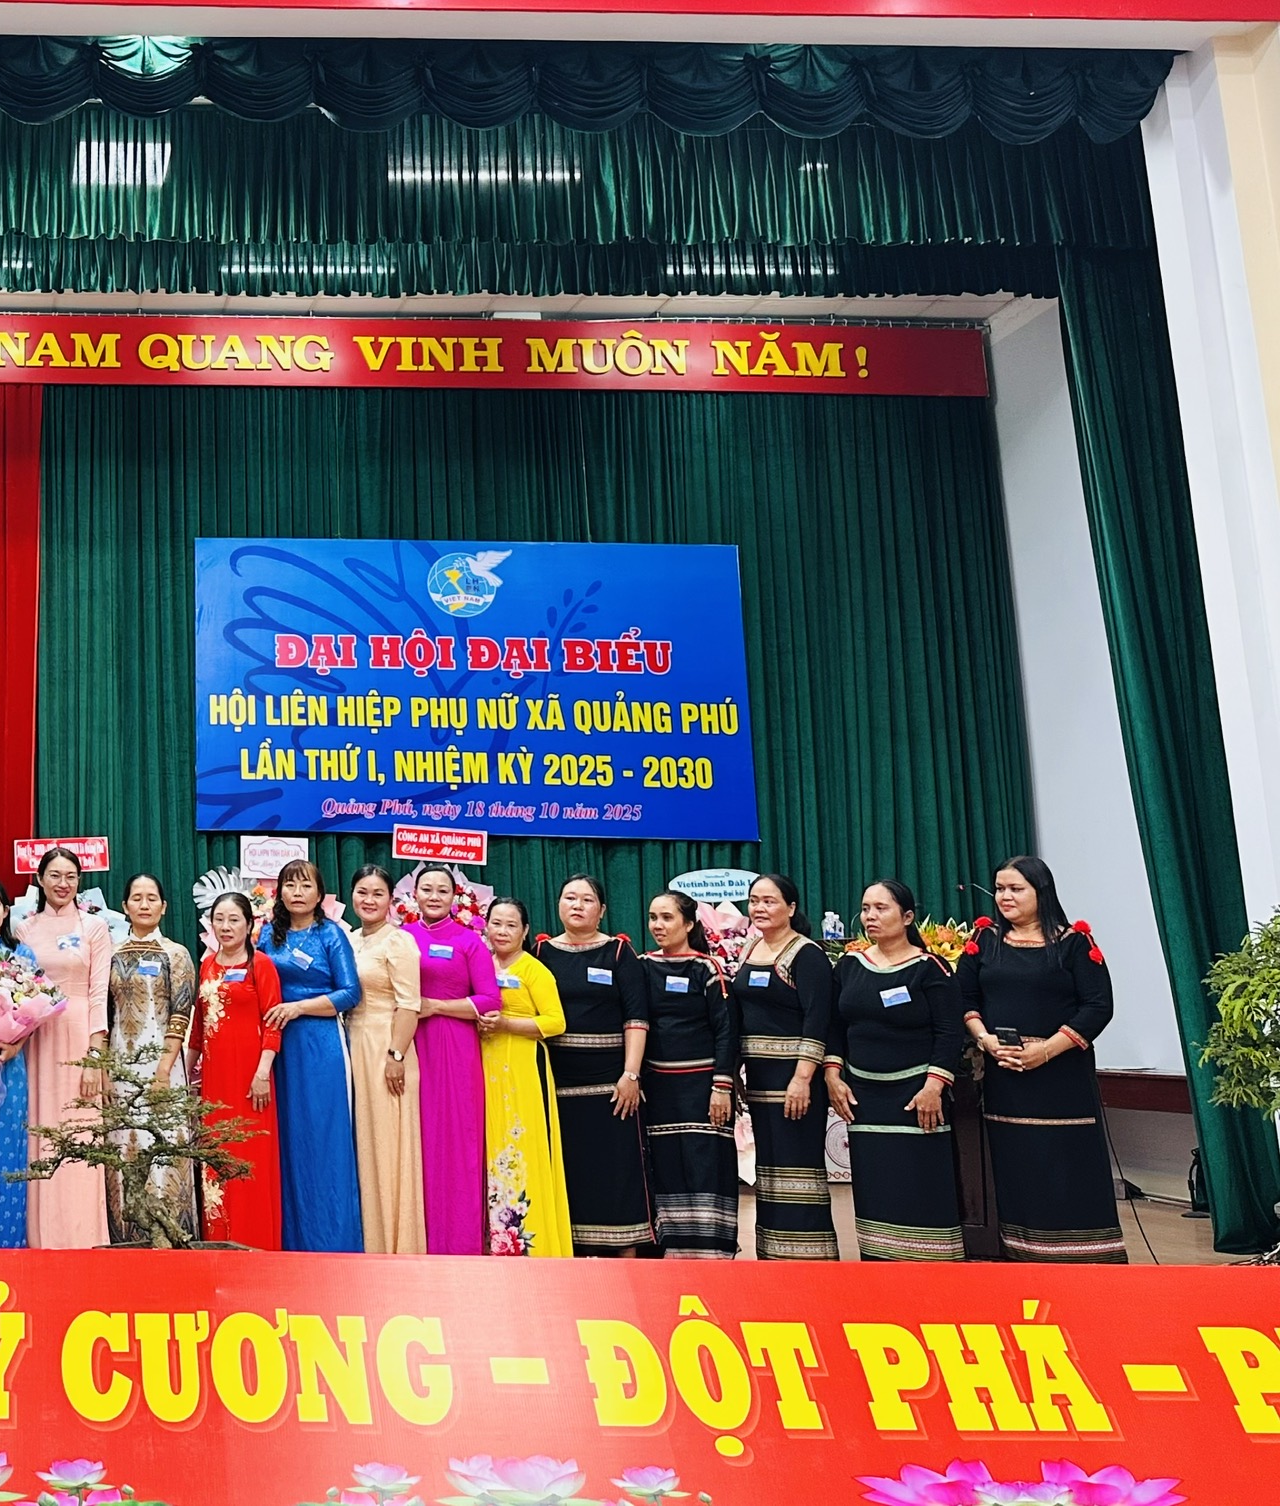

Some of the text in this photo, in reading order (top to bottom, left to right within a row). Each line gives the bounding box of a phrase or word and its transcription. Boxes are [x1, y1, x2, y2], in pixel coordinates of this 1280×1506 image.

[138, 333, 333, 373] QUANG
[353, 335, 504, 373] VINH
[526, 329, 689, 375] MUÔN
[275, 628, 673, 678] ĐẠI HỘI ĐẠI BIỂU
[209, 688, 739, 736] HỘI LIÊN HIỆP PHỤ NỮ XÃ QUẢNG PHÚ
[240, 737, 714, 791] LẦN THỨ I, NHIỆM KỲ 2025 - 2030
[321, 797, 643, 822] Quảng Phú, ngày 18 tháng 10 năm 2025
[397, 830, 482, 847] CÔNG AN XÃ QUẢNG PHÚ
[401, 843, 476, 860] Chúc Mừng
[677, 880, 726, 888] Vietinbank
[61, 1308, 452, 1425] CƯƠNG
[577, 1295, 825, 1458] ĐỘT
[843, 1300, 1114, 1433] PHÁ
